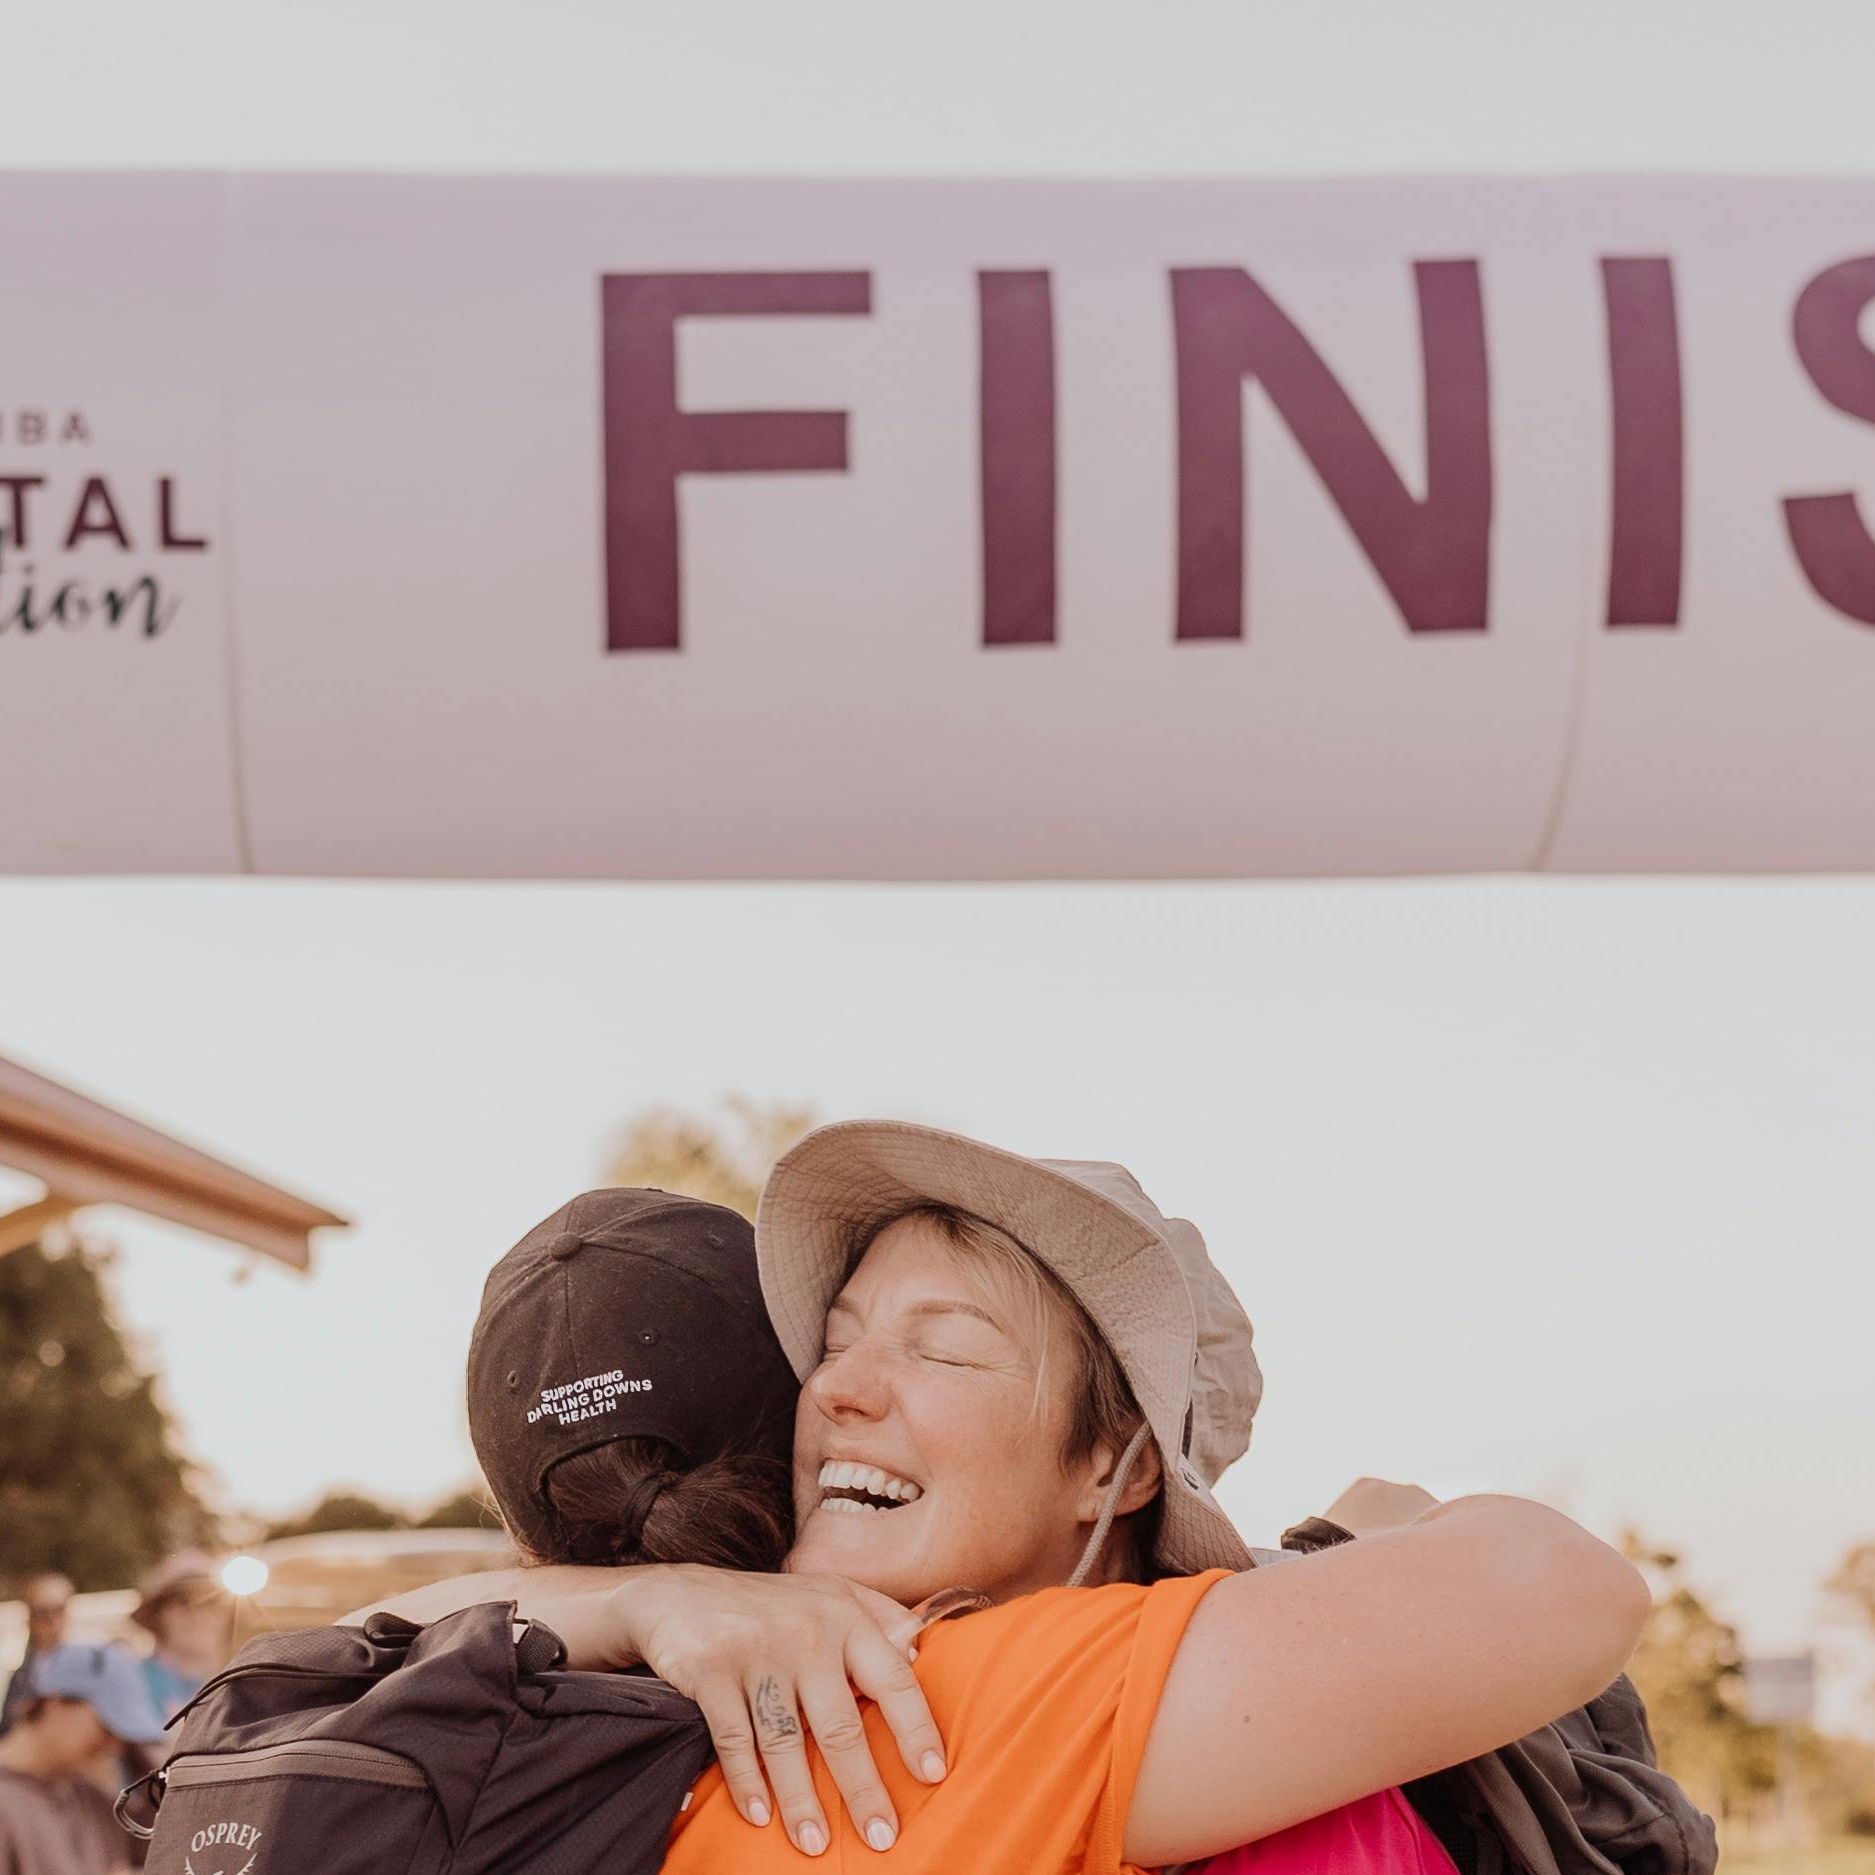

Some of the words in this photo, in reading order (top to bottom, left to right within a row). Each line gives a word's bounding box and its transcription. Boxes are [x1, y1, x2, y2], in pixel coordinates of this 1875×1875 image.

[527, 1393, 590, 1424] DARLING
[592, 1379, 653, 1402] DOWNS
[540, 1369, 624, 1402] SUPPORTING
[558, 1398, 617, 1425] HEALTH
[191, 1822, 262, 1853] OSPREY
